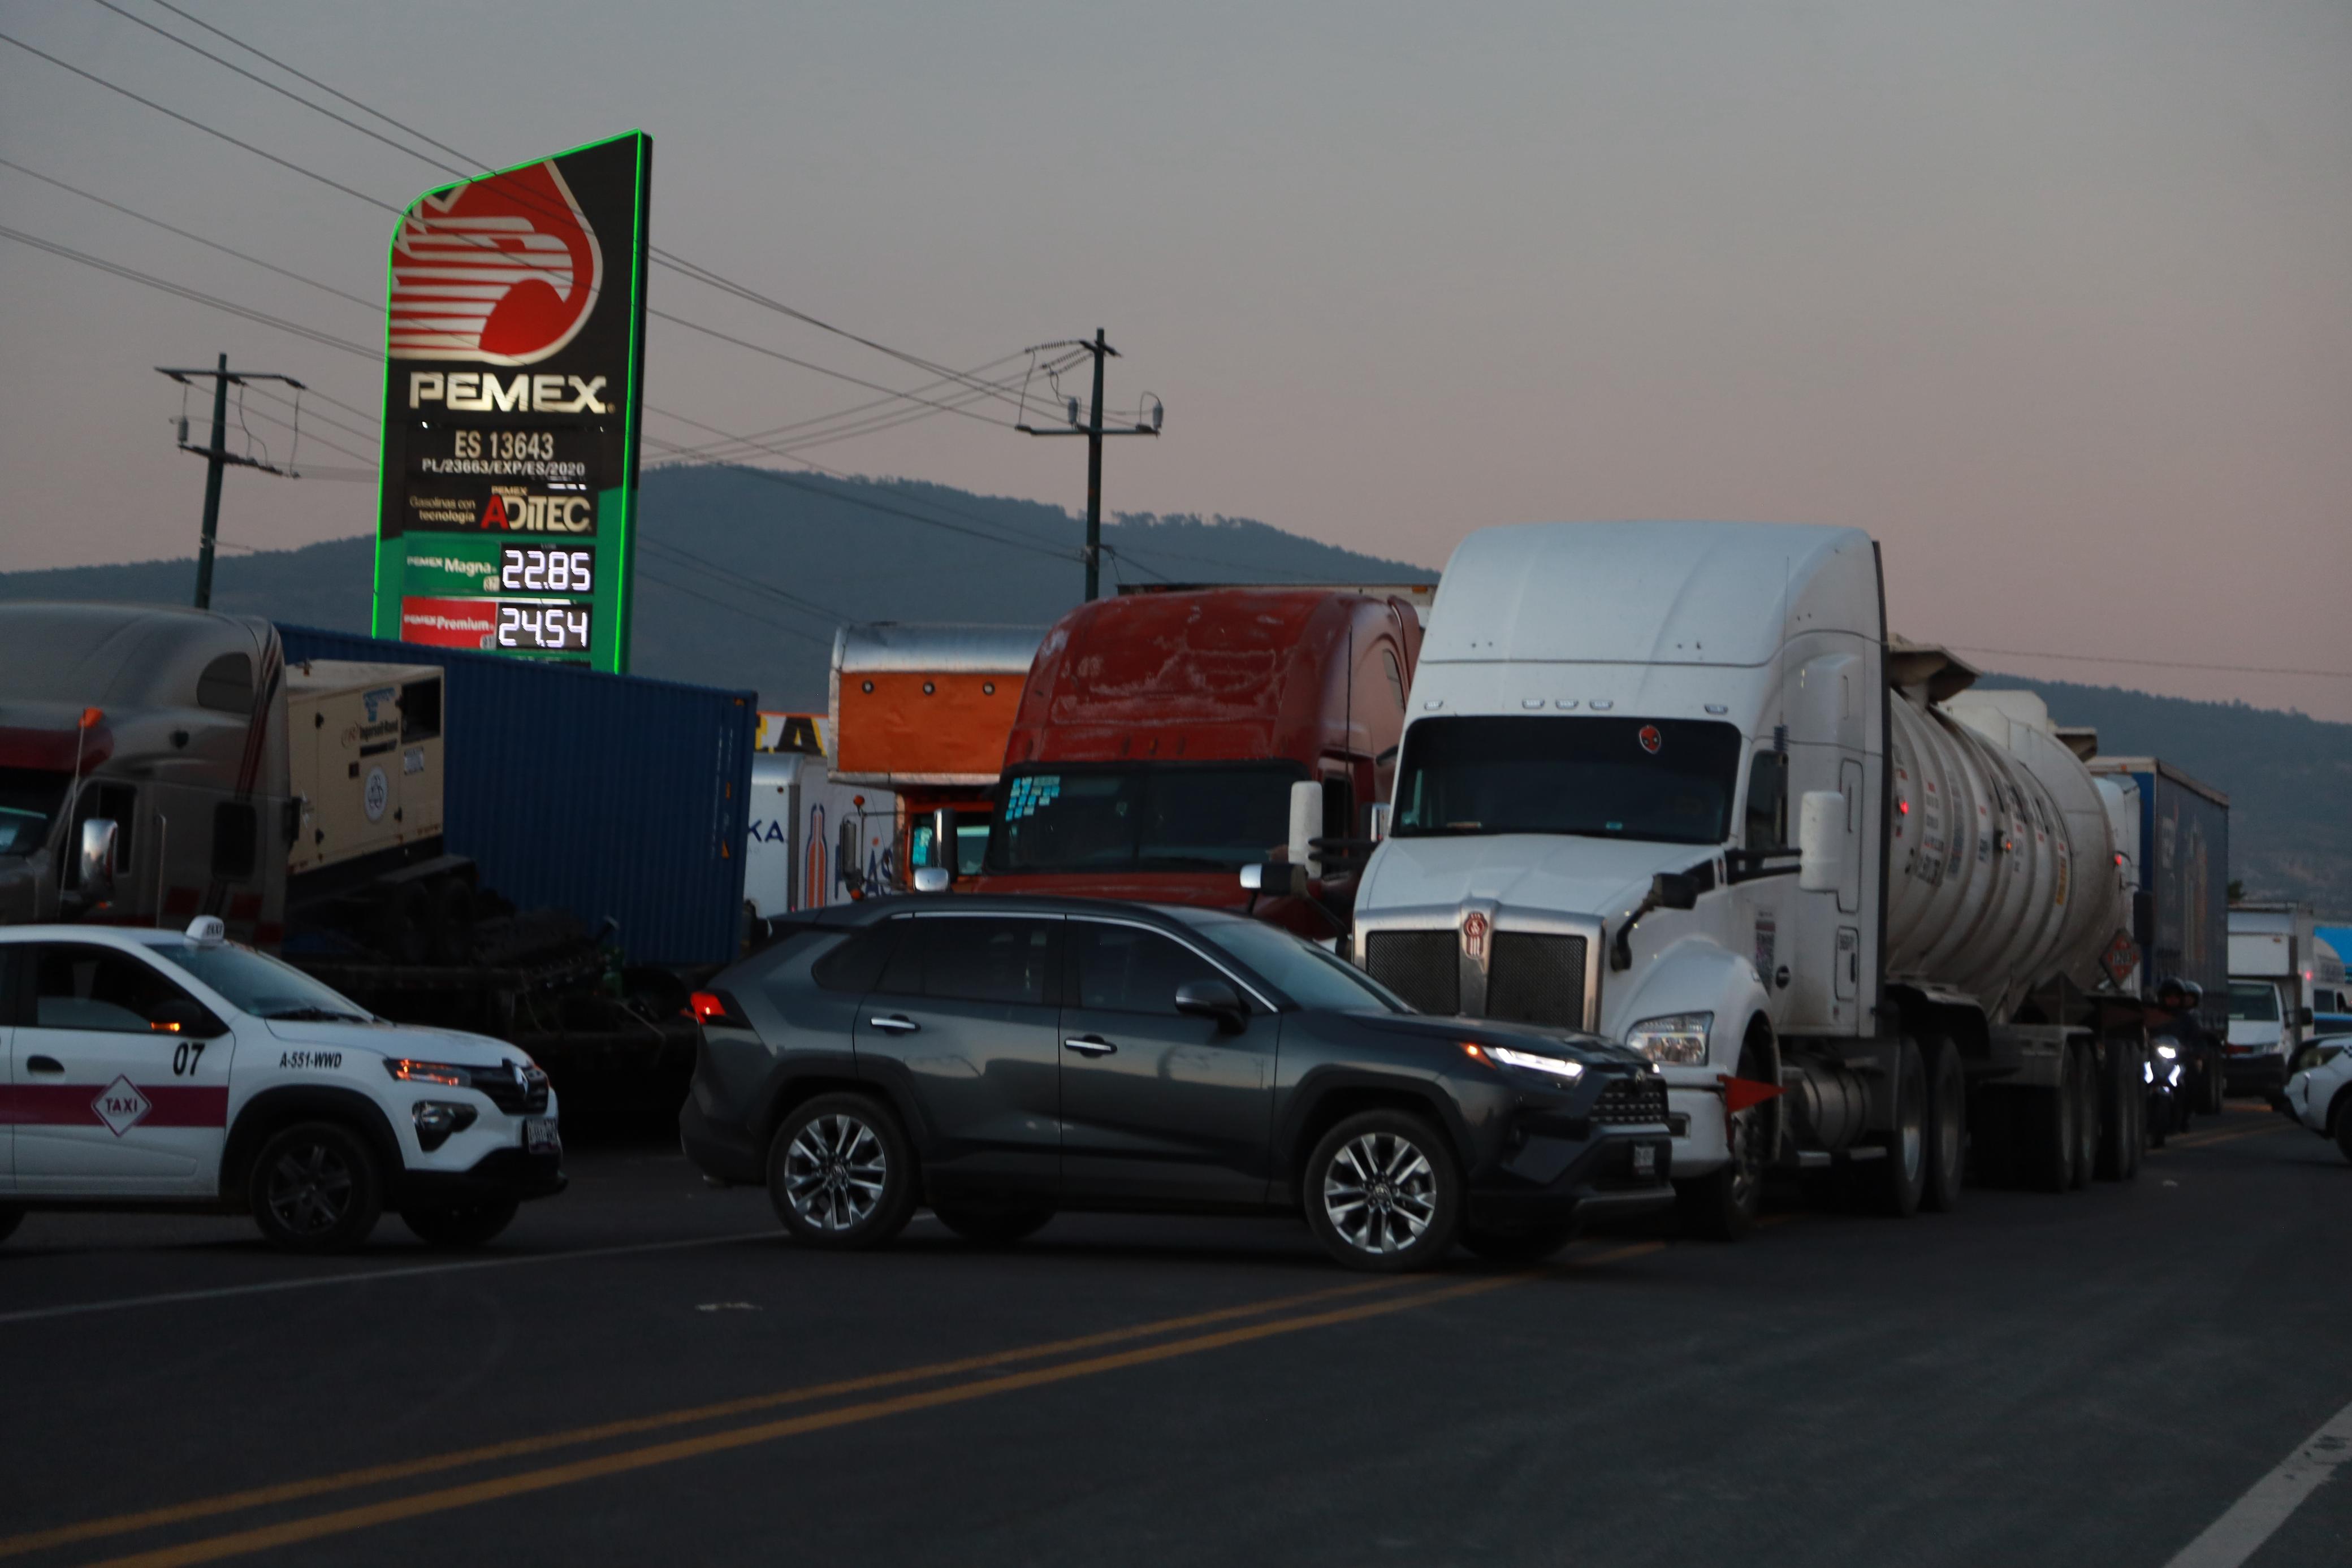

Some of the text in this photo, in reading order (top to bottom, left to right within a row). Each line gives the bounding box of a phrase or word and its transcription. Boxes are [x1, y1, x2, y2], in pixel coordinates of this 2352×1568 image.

[409, 371, 606, 414] PEMEX
[455, 430, 554, 461] ES 13643
[491, 486, 528, 496] PEMEX
[409, 495, 475, 509] Gasolinas con
[419, 510, 475, 525] tecnología
[407, 556, 492, 577] PEMEX Magna
[502, 549, 591, 591] 22.85
[404, 614, 490, 631] PEMEX Premium
[498, 608, 588, 648] 24.54
[172, 1042, 205, 1076] 07
[279, 1051, 342, 1069] A-551-WWD
[106, 1098, 138, 1114] TAXI
